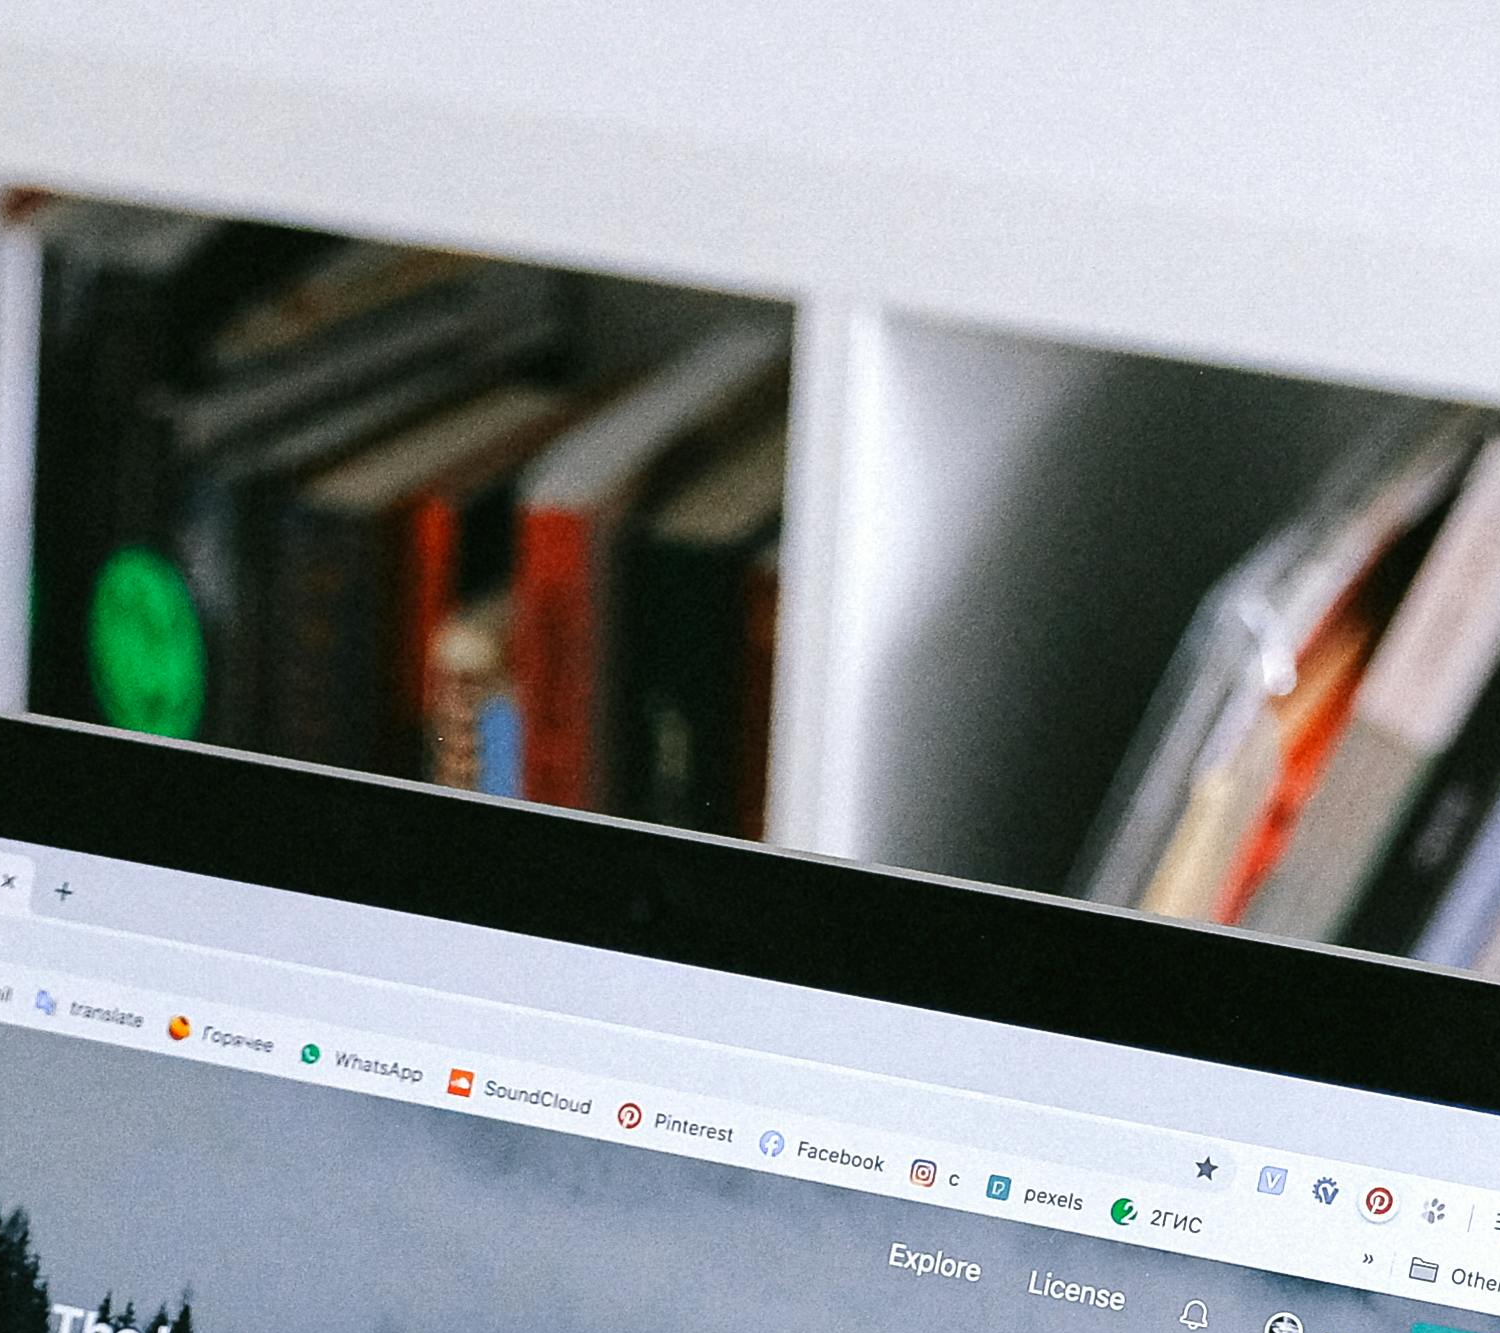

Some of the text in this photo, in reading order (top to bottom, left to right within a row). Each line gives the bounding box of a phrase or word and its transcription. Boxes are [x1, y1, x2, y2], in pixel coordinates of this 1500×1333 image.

[70, 999, 145, 1029] translate
[201, 1025, 275, 1054] Горячее
[334, 1050, 424, 1084] WhatsApp
[483, 1078, 593, 1117] SoundCloud
[654, 1111, 734, 1145] Pinterest
[797, 1140, 886, 1173] Facebook
[1023, 1184, 1084, 1213] pexels
[1149, 1206, 1203, 1234] 2ГИС
[889, 1242, 982, 1284] Explore
[1027, 1269, 1127, 1313] License
